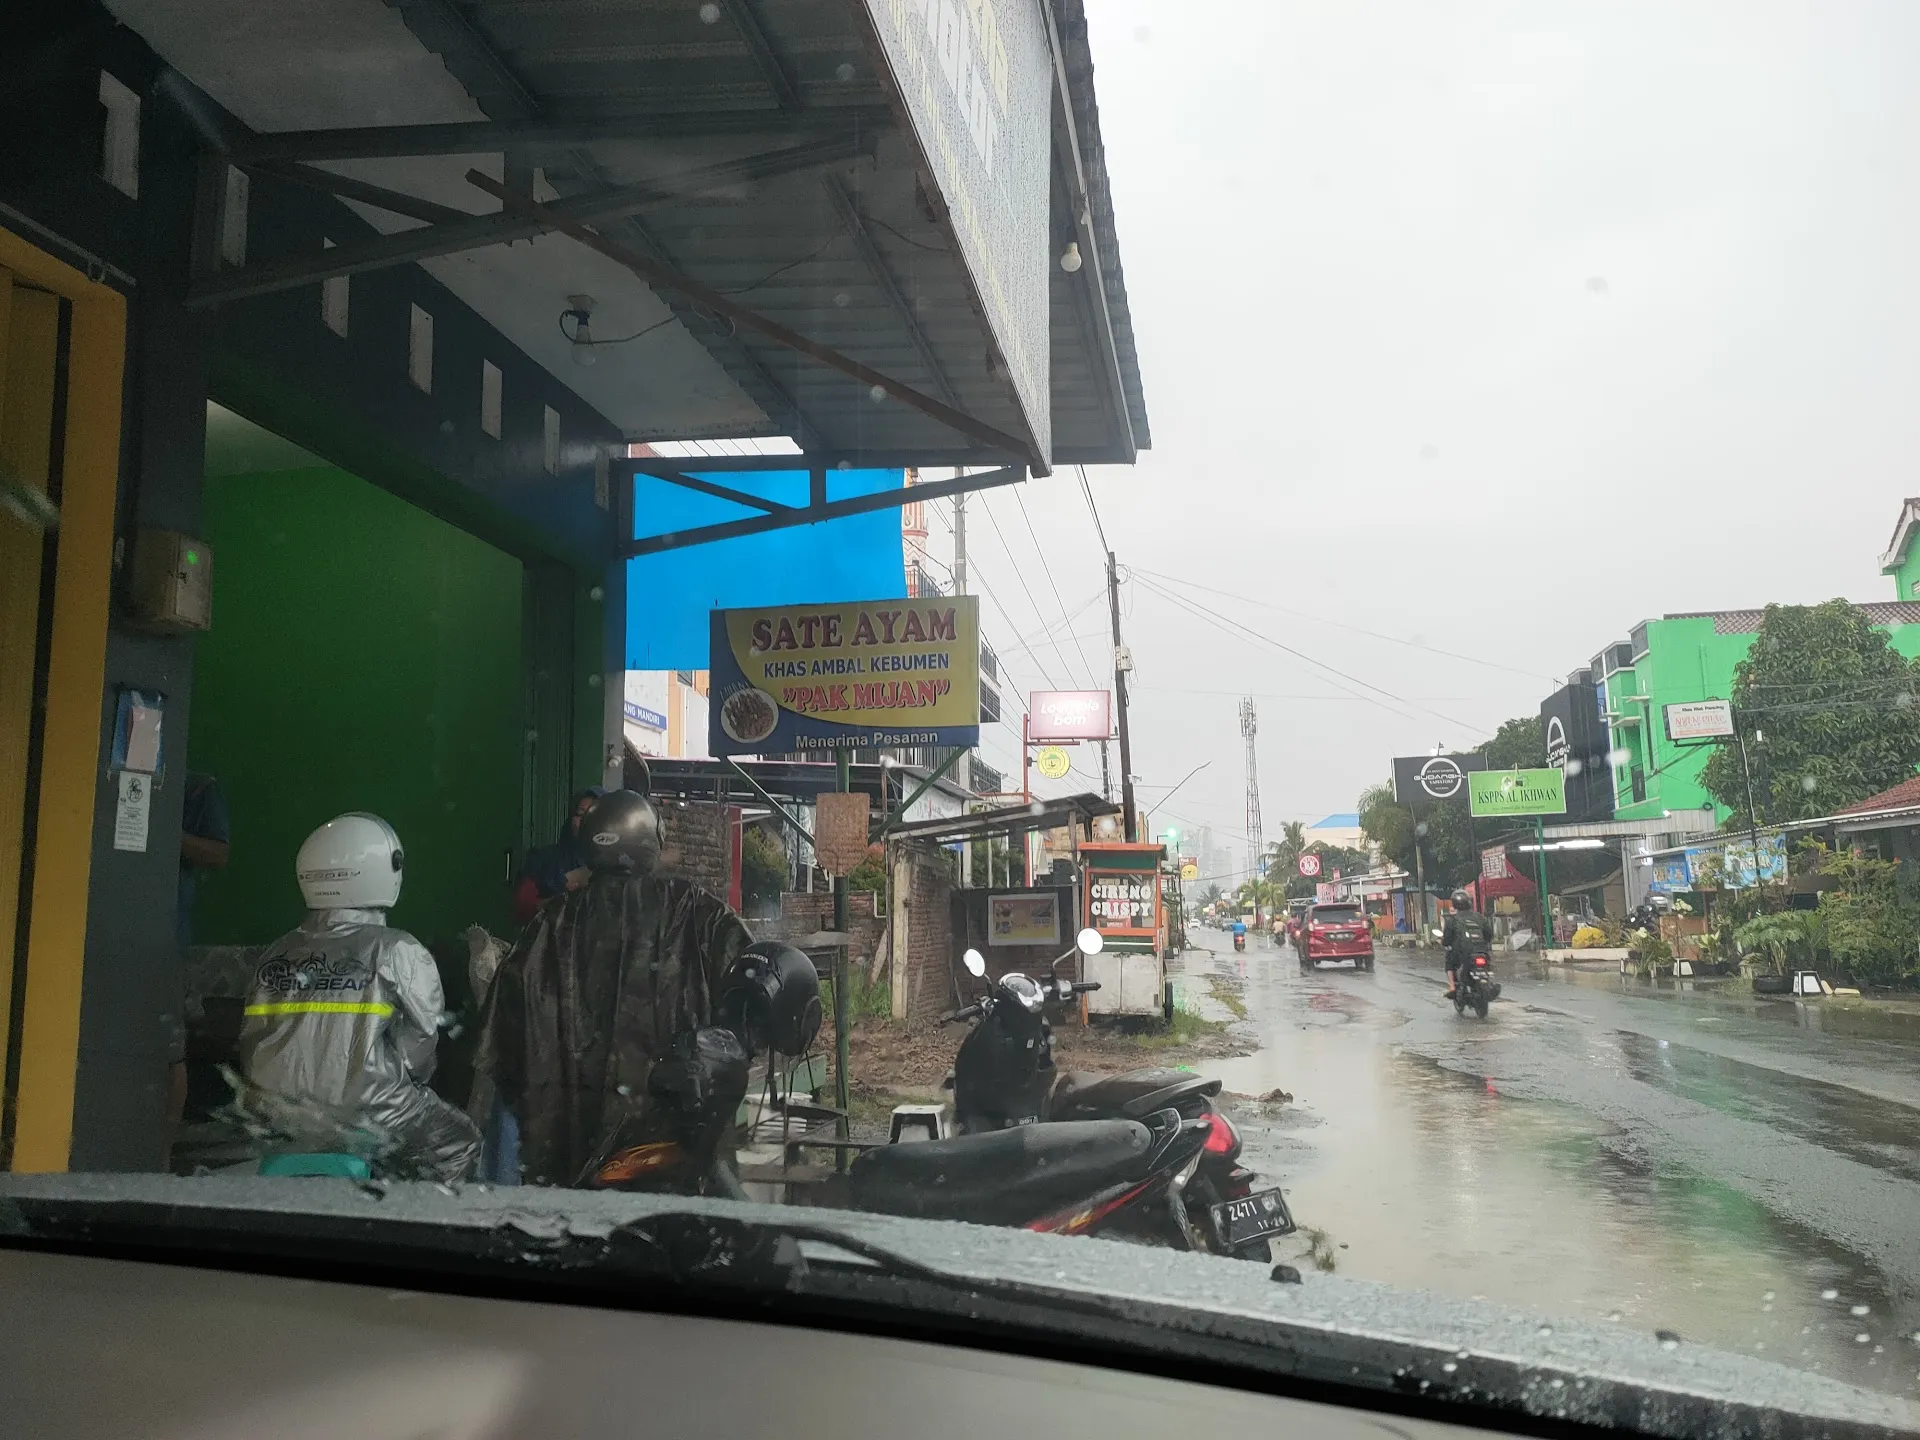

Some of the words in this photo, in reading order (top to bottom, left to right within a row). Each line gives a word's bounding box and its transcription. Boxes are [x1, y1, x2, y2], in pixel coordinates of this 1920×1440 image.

[752, 612, 844, 652] SATE
[850, 606, 958, 647] AYAM
[763, 659, 807, 679] KHAS
[810, 656, 866, 677] AMBAL
[869, 652, 950, 674] KEBUMEN
[795, 730, 868, 749] Menerima
[873, 730, 939, 748] Pesanan
[1478, 791, 1505, 804] KSPPS
[1506, 790, 1518, 802] AL
[1520, 788, 1557, 802] IKHWAN
[1091, 884, 1151, 900] CIRENG
[1091, 901, 1151, 917] CRISPY
[1228, 1201, 1258, 1222] 2471
